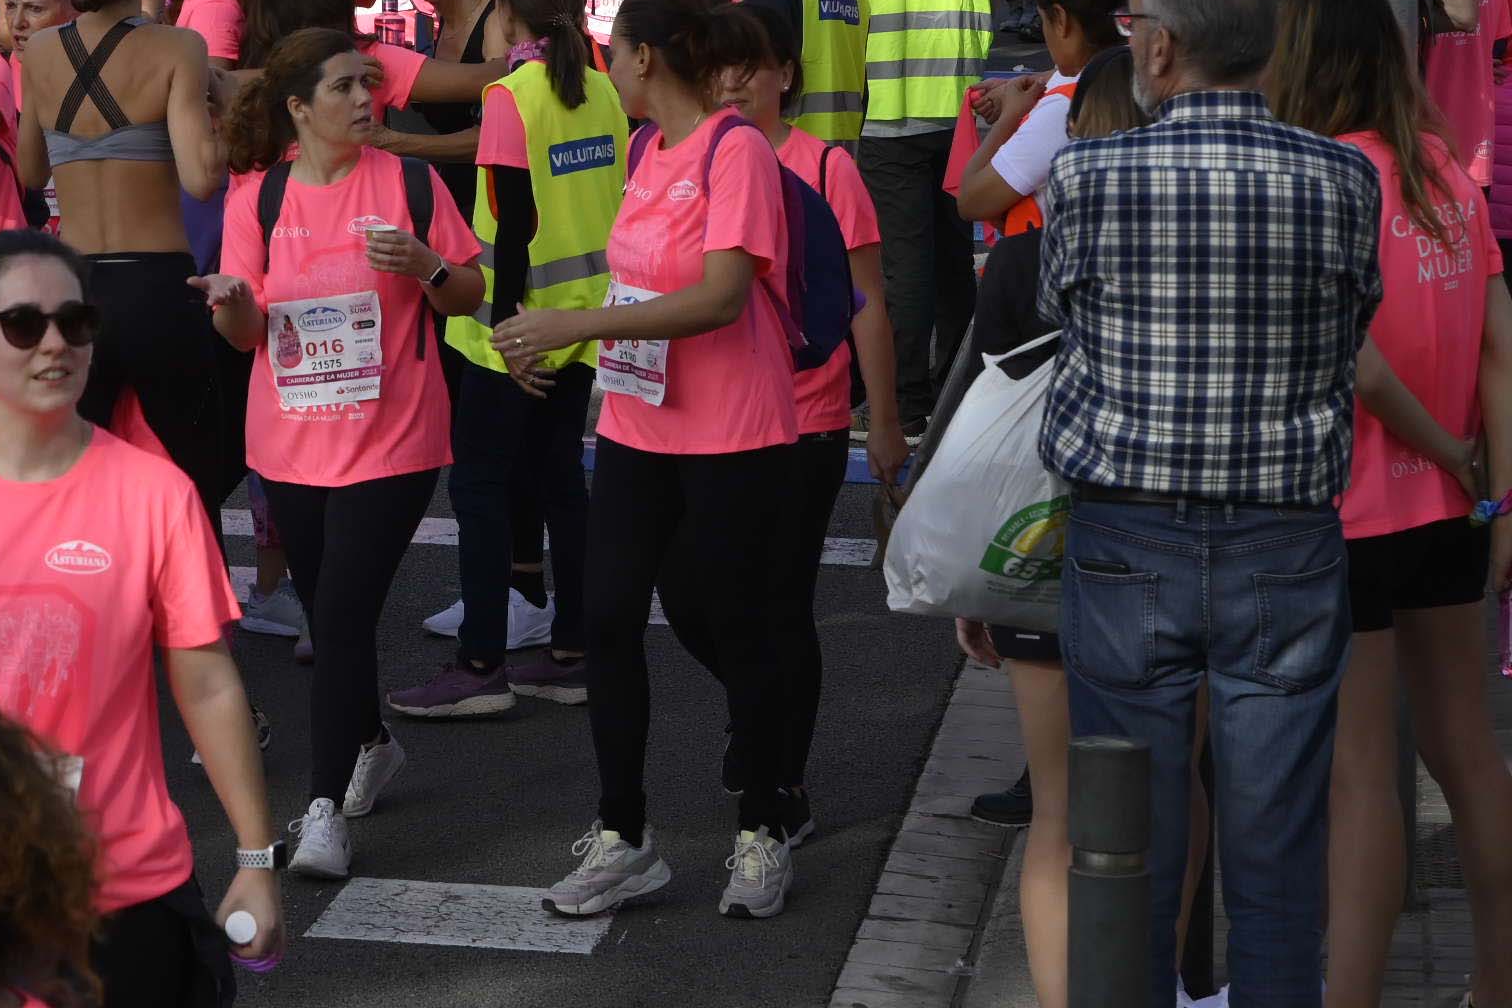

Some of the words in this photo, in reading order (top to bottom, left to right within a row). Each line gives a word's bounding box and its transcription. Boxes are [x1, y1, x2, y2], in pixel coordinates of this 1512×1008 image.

[1417, 248, 1473, 283] MUJER
[349, 305, 373, 315] SUMA
[301, 316, 343, 328] ASTURIANA
[305, 339, 345, 357] 016
[311, 358, 342, 371] 21575
[286, 376, 315, 384] CARRERA
[315, 374, 325, 382] DE
[326, 373, 336, 381] LA
[336, 371, 360, 379] MUJER
[287, 390, 318, 400] OYSHO
[345, 383, 379, 394] Santande
[48, 551, 108, 568] ASTURIANA
